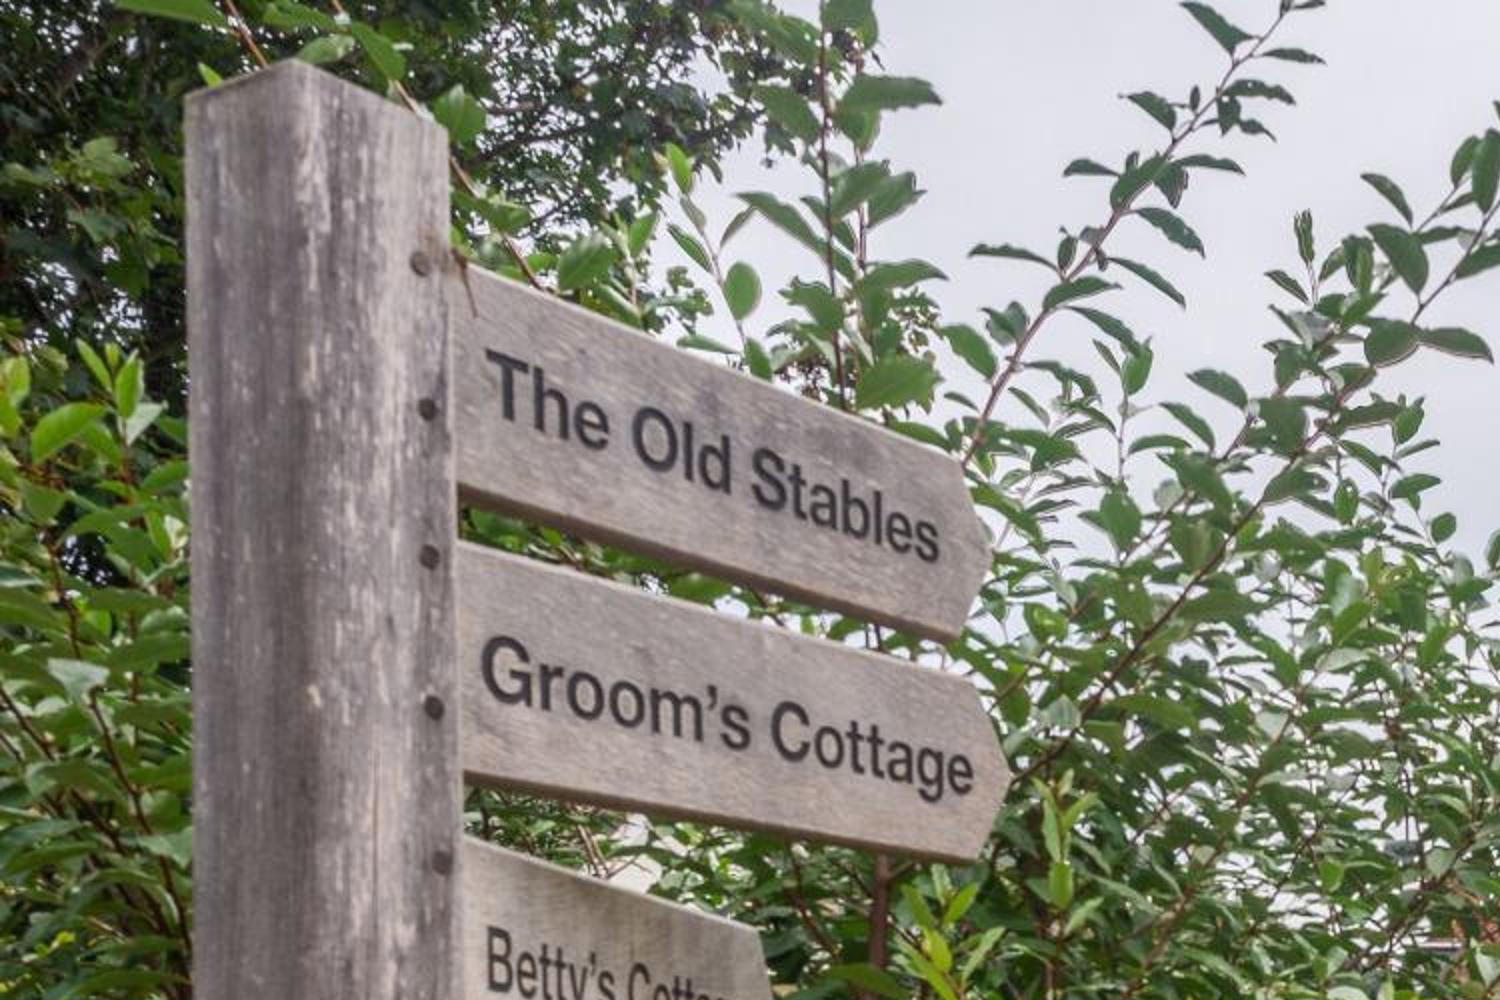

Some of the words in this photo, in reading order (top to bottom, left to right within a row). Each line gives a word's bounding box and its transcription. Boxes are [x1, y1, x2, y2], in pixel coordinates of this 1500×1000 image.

[486, 349, 610, 450] The
[633, 405, 731, 495] Old
[751, 447, 941, 563] Stables
[480, 635, 751, 751] Groom's
[771, 701, 975, 802] Cottage
